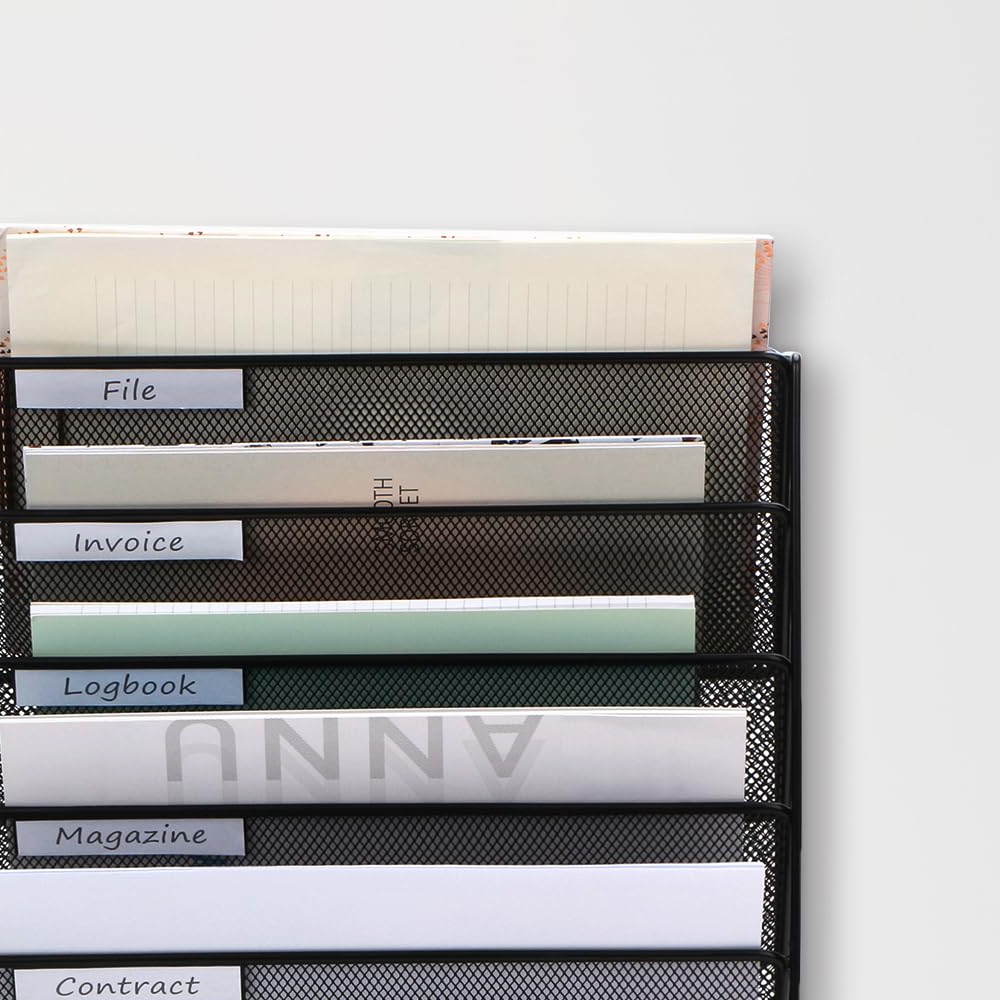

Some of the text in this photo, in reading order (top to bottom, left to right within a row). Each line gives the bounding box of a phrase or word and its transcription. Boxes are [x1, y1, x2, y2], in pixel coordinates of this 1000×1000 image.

[103, 377, 157, 401] File
[398, 484, 420, 553] SORET
[74, 530, 185, 553] Invoice
[64, 673, 198, 702] Logbook
[55, 823, 208, 849] Magazine
[55, 976, 201, 997] Contract
